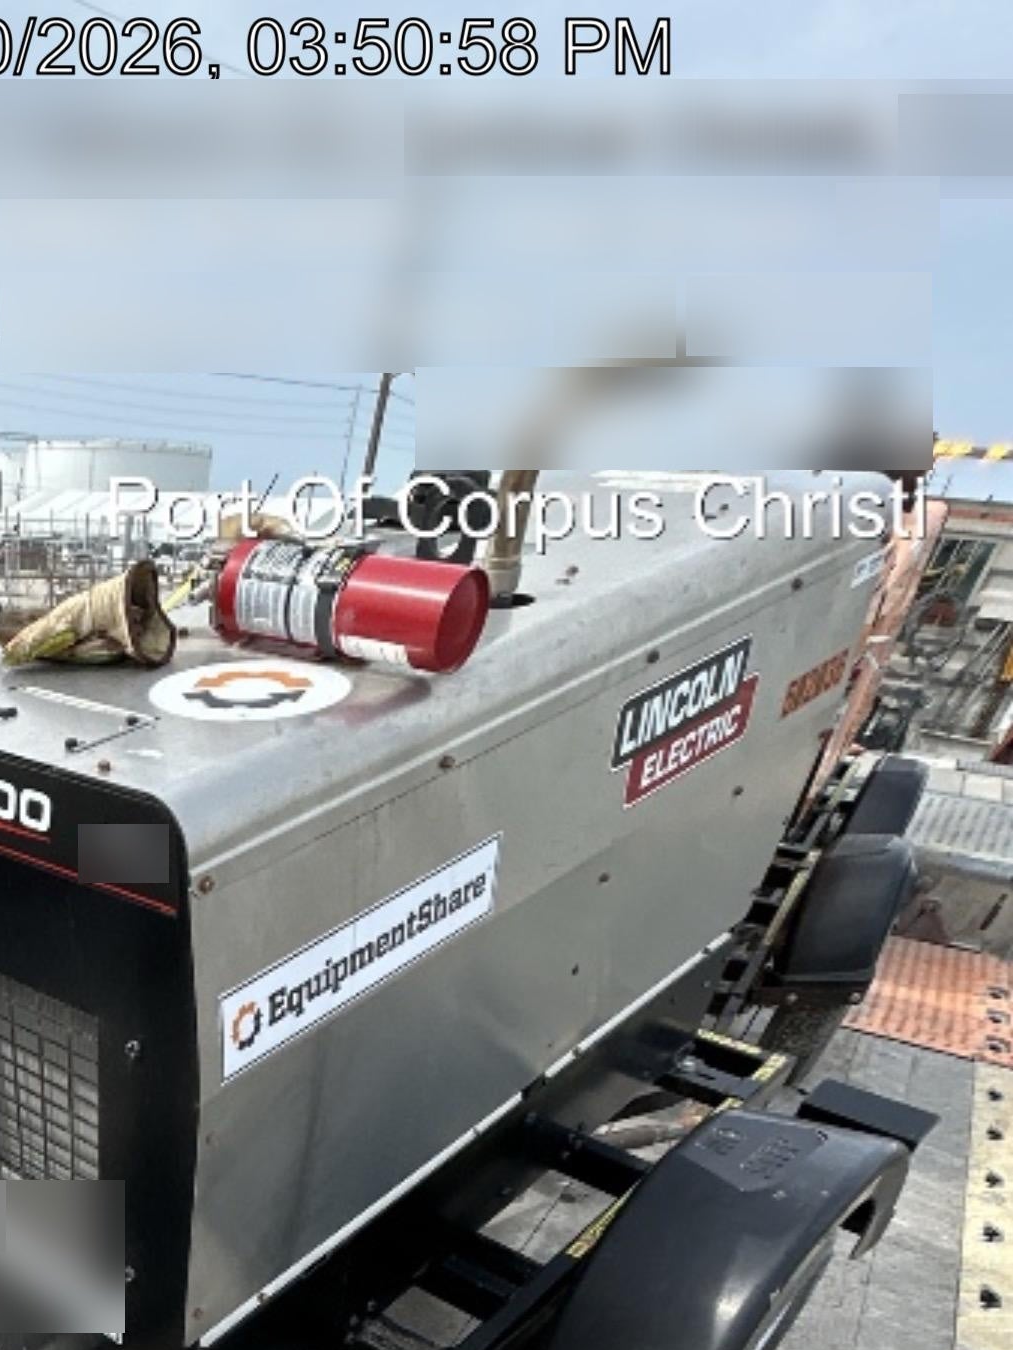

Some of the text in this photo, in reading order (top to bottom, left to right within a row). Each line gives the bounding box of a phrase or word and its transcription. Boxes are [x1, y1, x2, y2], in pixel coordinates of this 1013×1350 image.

[619, 650, 745, 757] LINCOLN
[640, 703, 742, 788] ELECTRIC
[267, 870, 488, 1027] EquipmentShare
